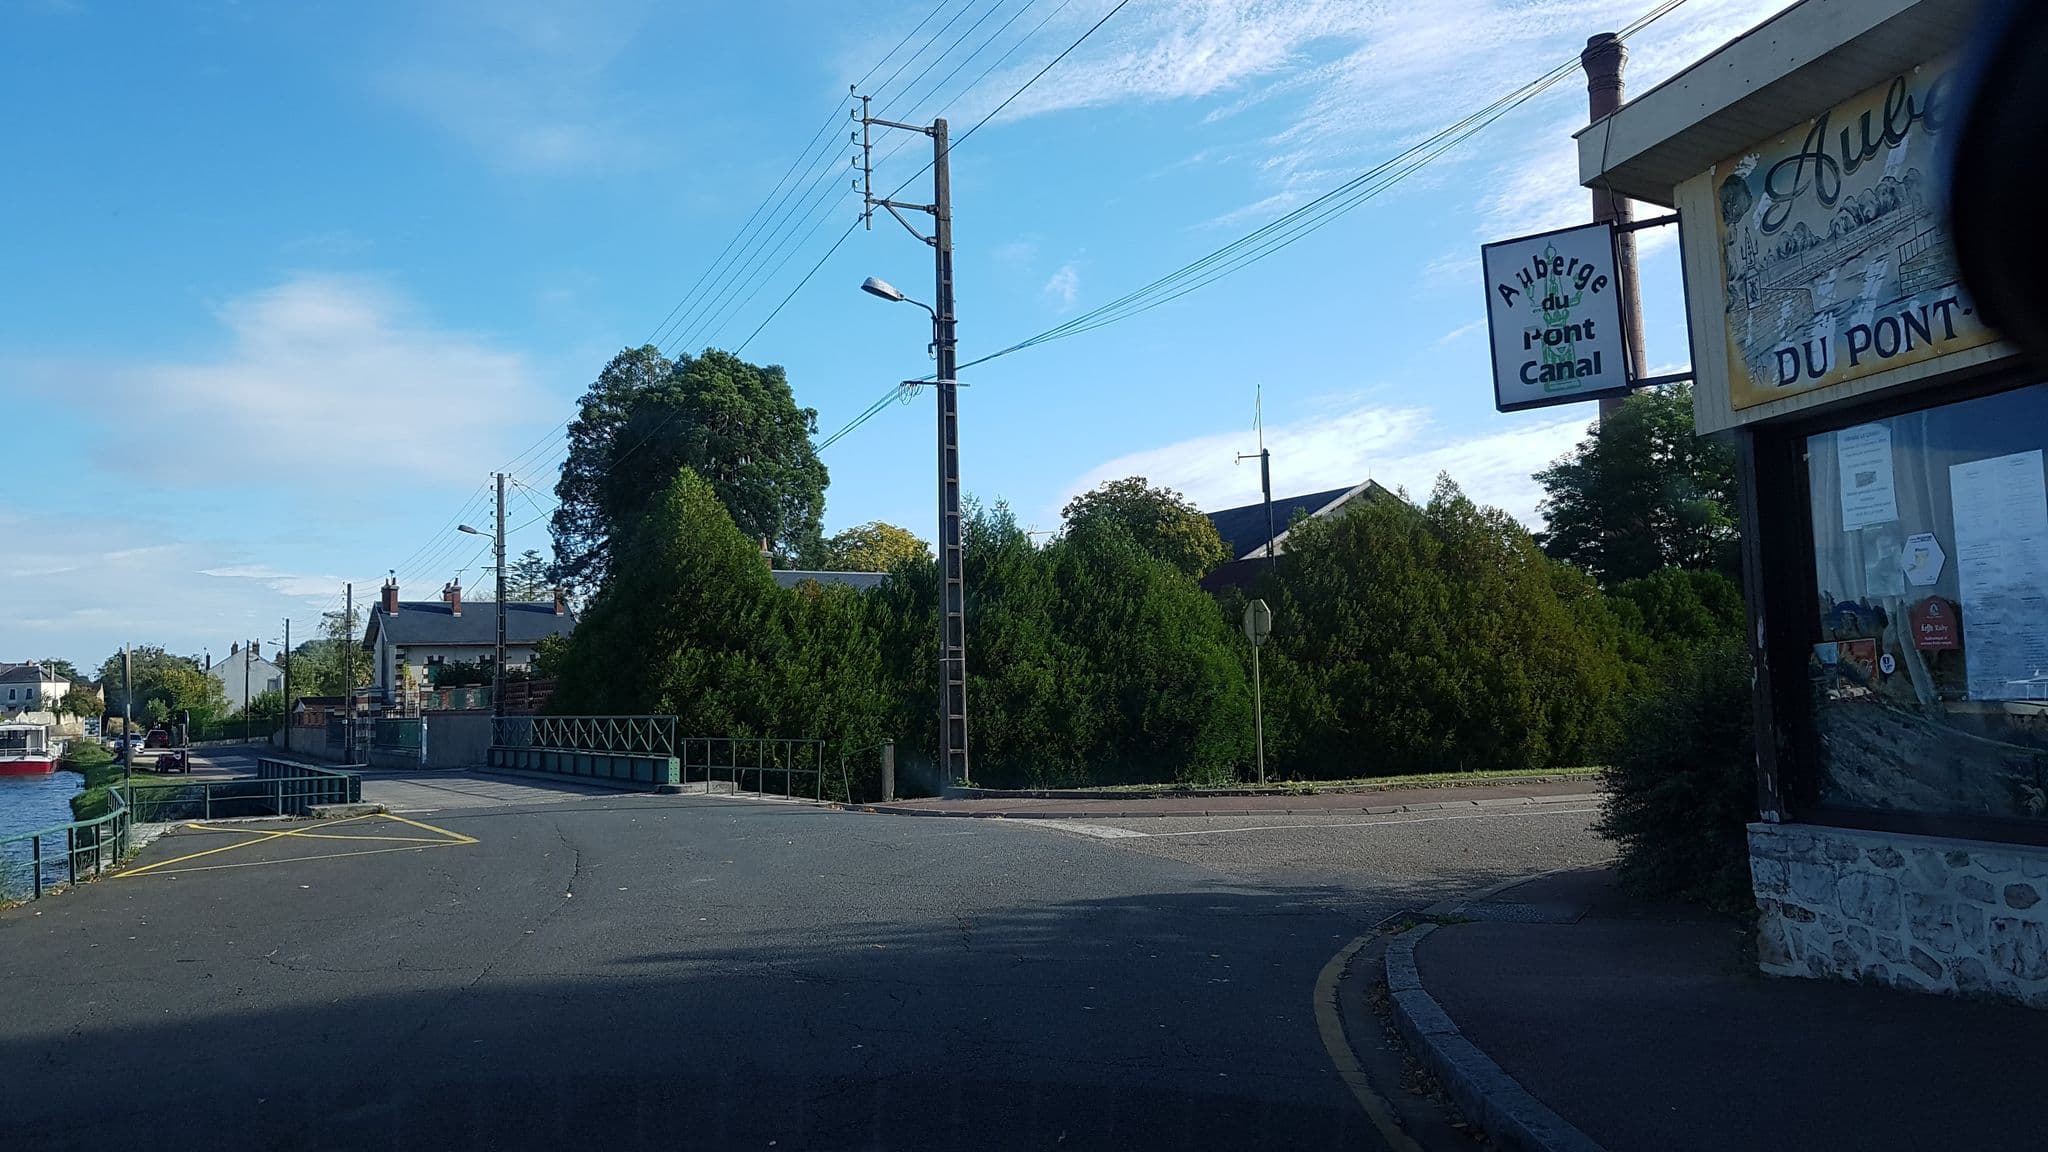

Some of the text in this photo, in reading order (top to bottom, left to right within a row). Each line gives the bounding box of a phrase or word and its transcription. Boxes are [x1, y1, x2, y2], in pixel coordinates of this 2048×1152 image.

[1760, 74, 1954, 234] Aube
[1498, 254, 1608, 308] Auberge
[1541, 293, 1569, 311] du
[1519, 351, 1602, 386] Canal
[1774, 296, 1974, 387] DU PONT-
